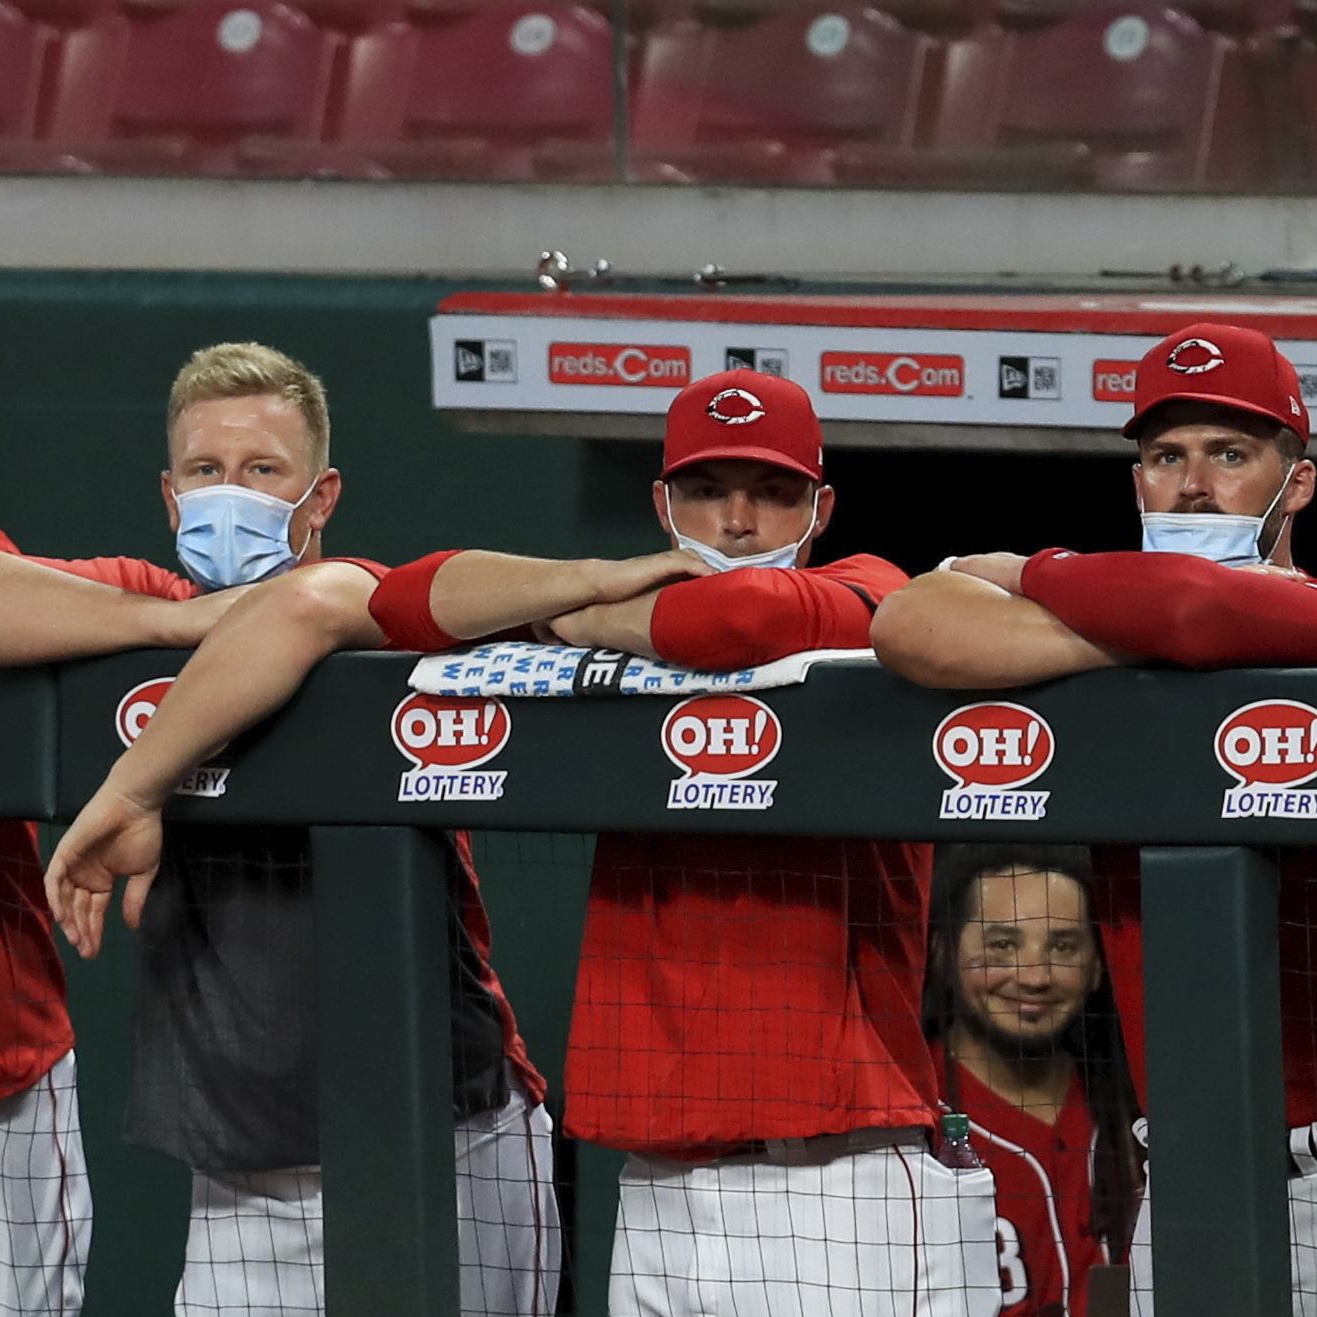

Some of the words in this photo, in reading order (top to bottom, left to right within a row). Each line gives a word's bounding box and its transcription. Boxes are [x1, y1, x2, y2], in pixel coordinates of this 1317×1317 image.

[400, 702, 497, 748] OH!
[671, 709, 768, 757] OH!
[942, 720, 1040, 767] OH!
[403, 775, 500, 796] LOTTERY
[671, 784, 770, 804] LOTTERY
[944, 794, 1043, 815] LOTTERY
